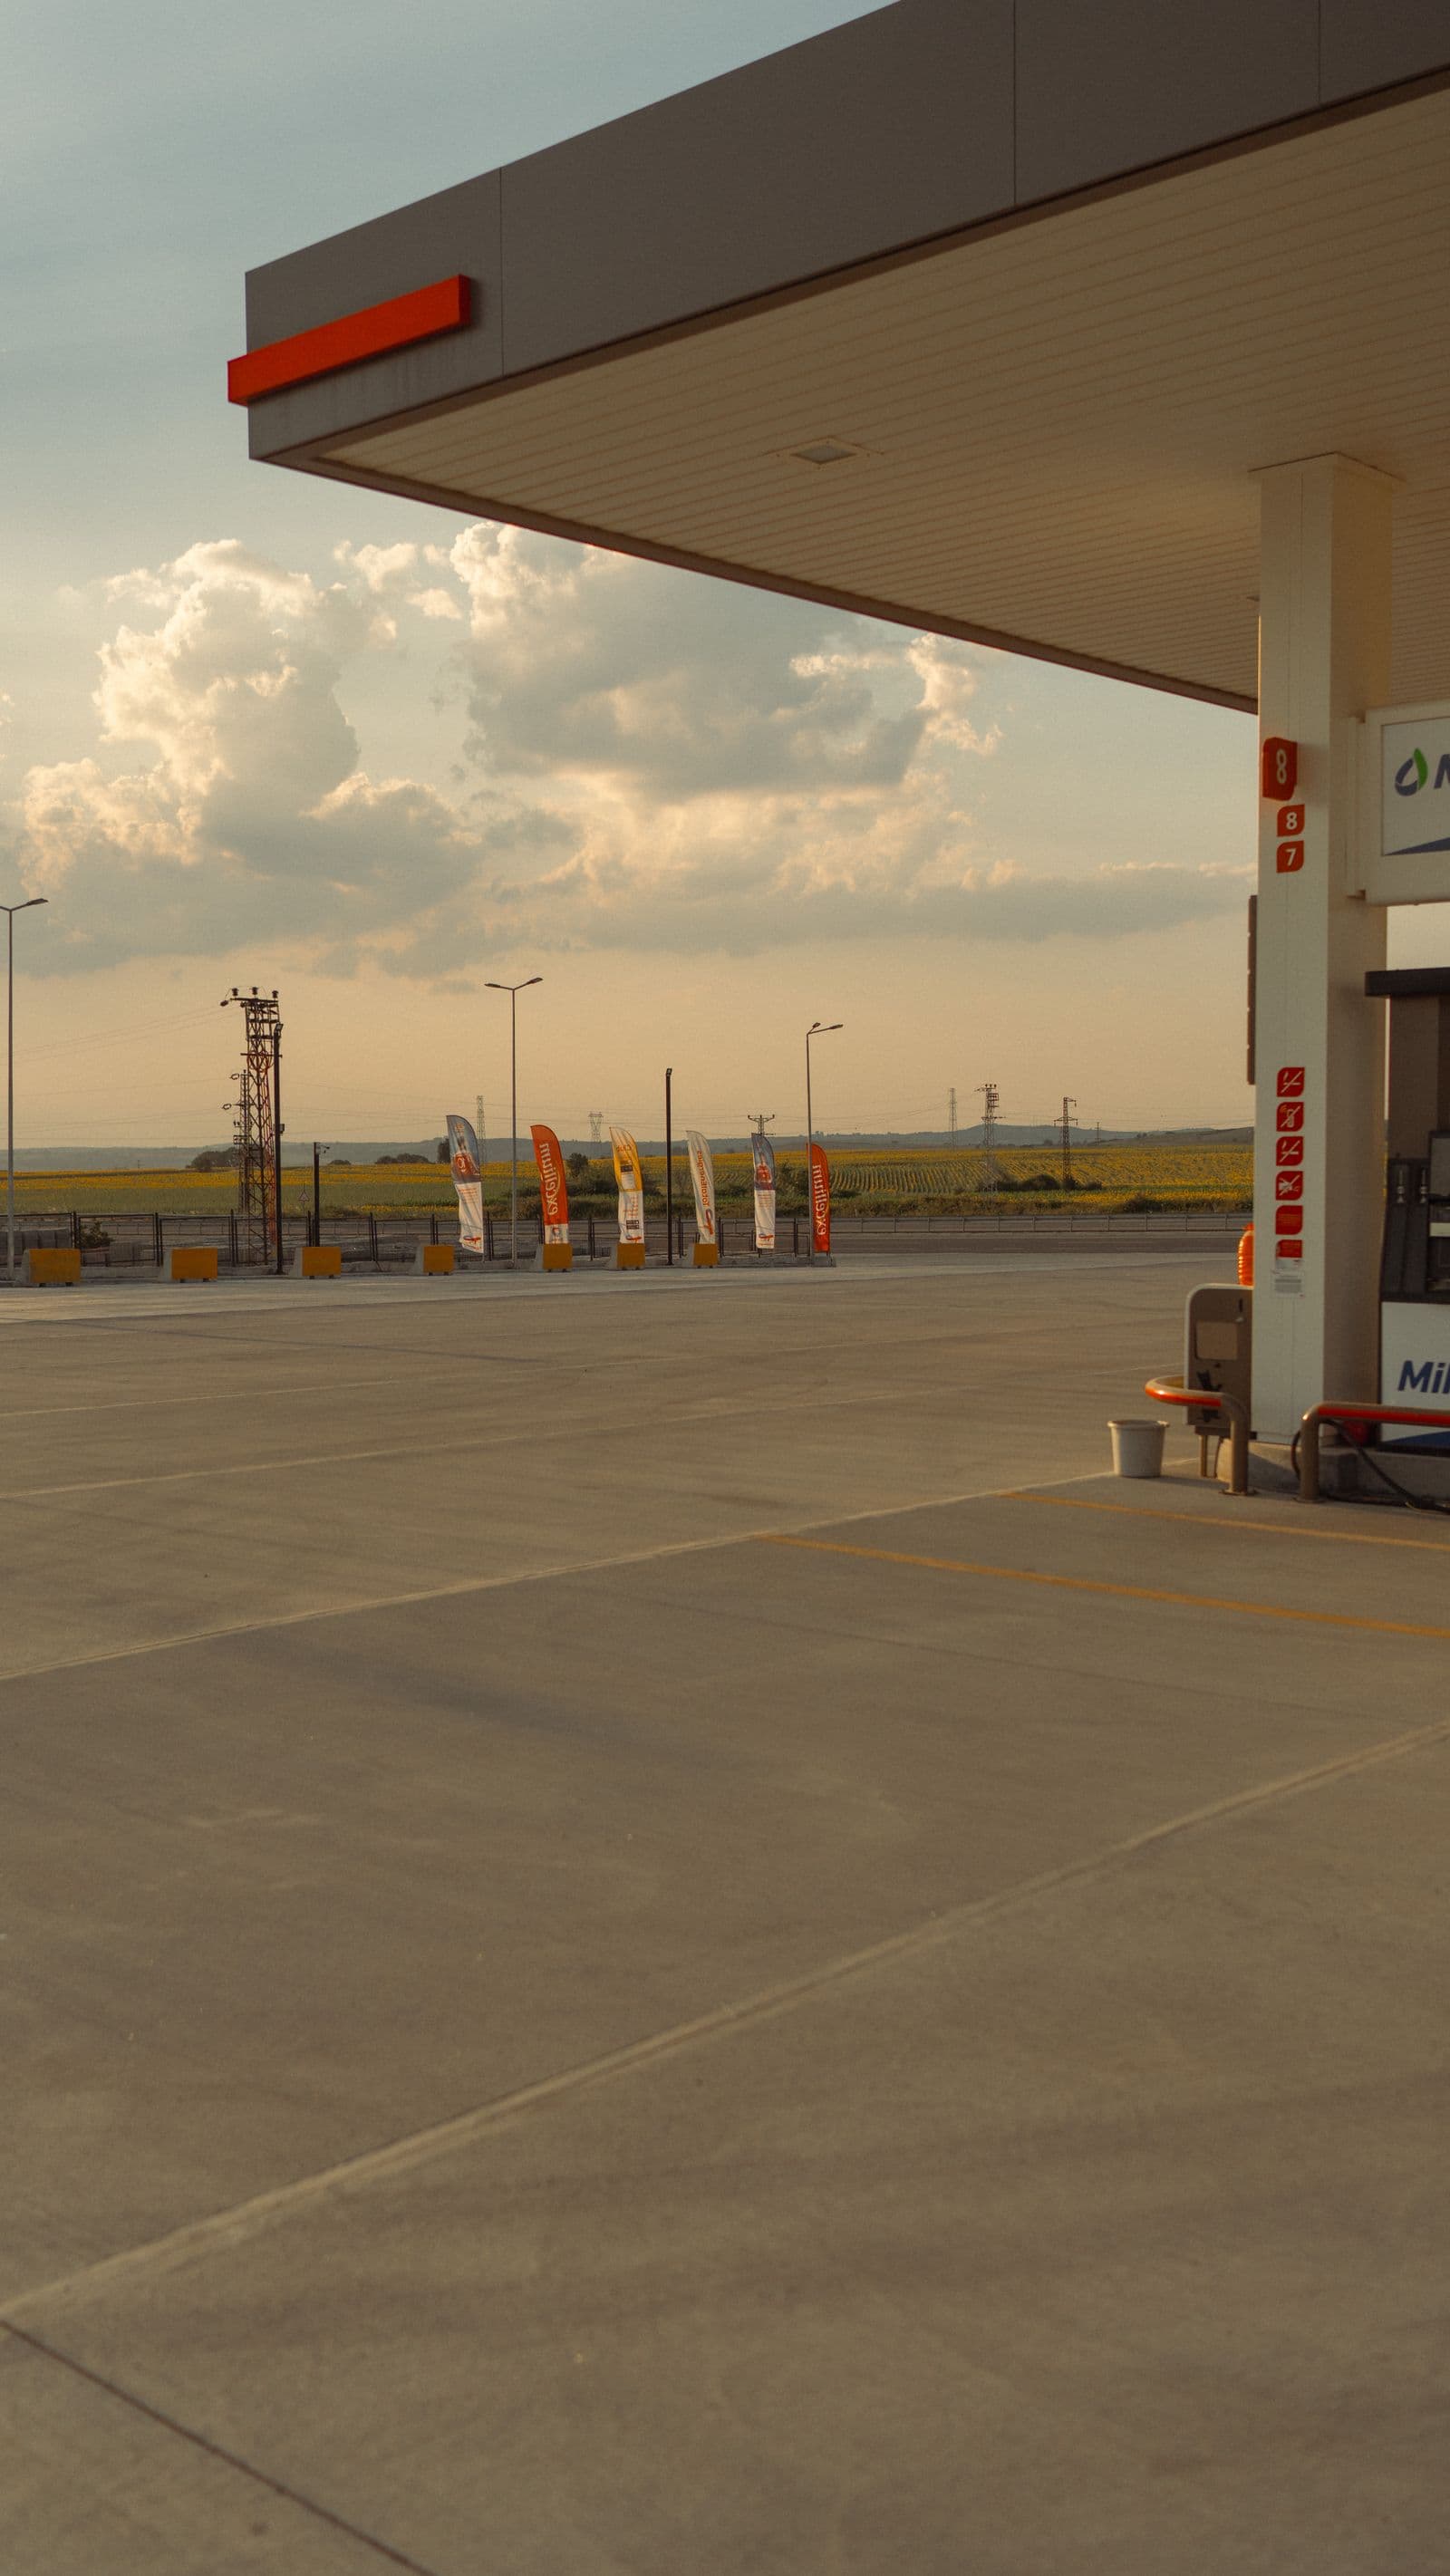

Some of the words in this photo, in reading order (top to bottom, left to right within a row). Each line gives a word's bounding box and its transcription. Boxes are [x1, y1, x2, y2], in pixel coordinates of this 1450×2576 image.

[1276, 748, 1288, 785] 8
[1286, 812, 1297, 830] 8
[1286, 847, 1297, 866] 7
